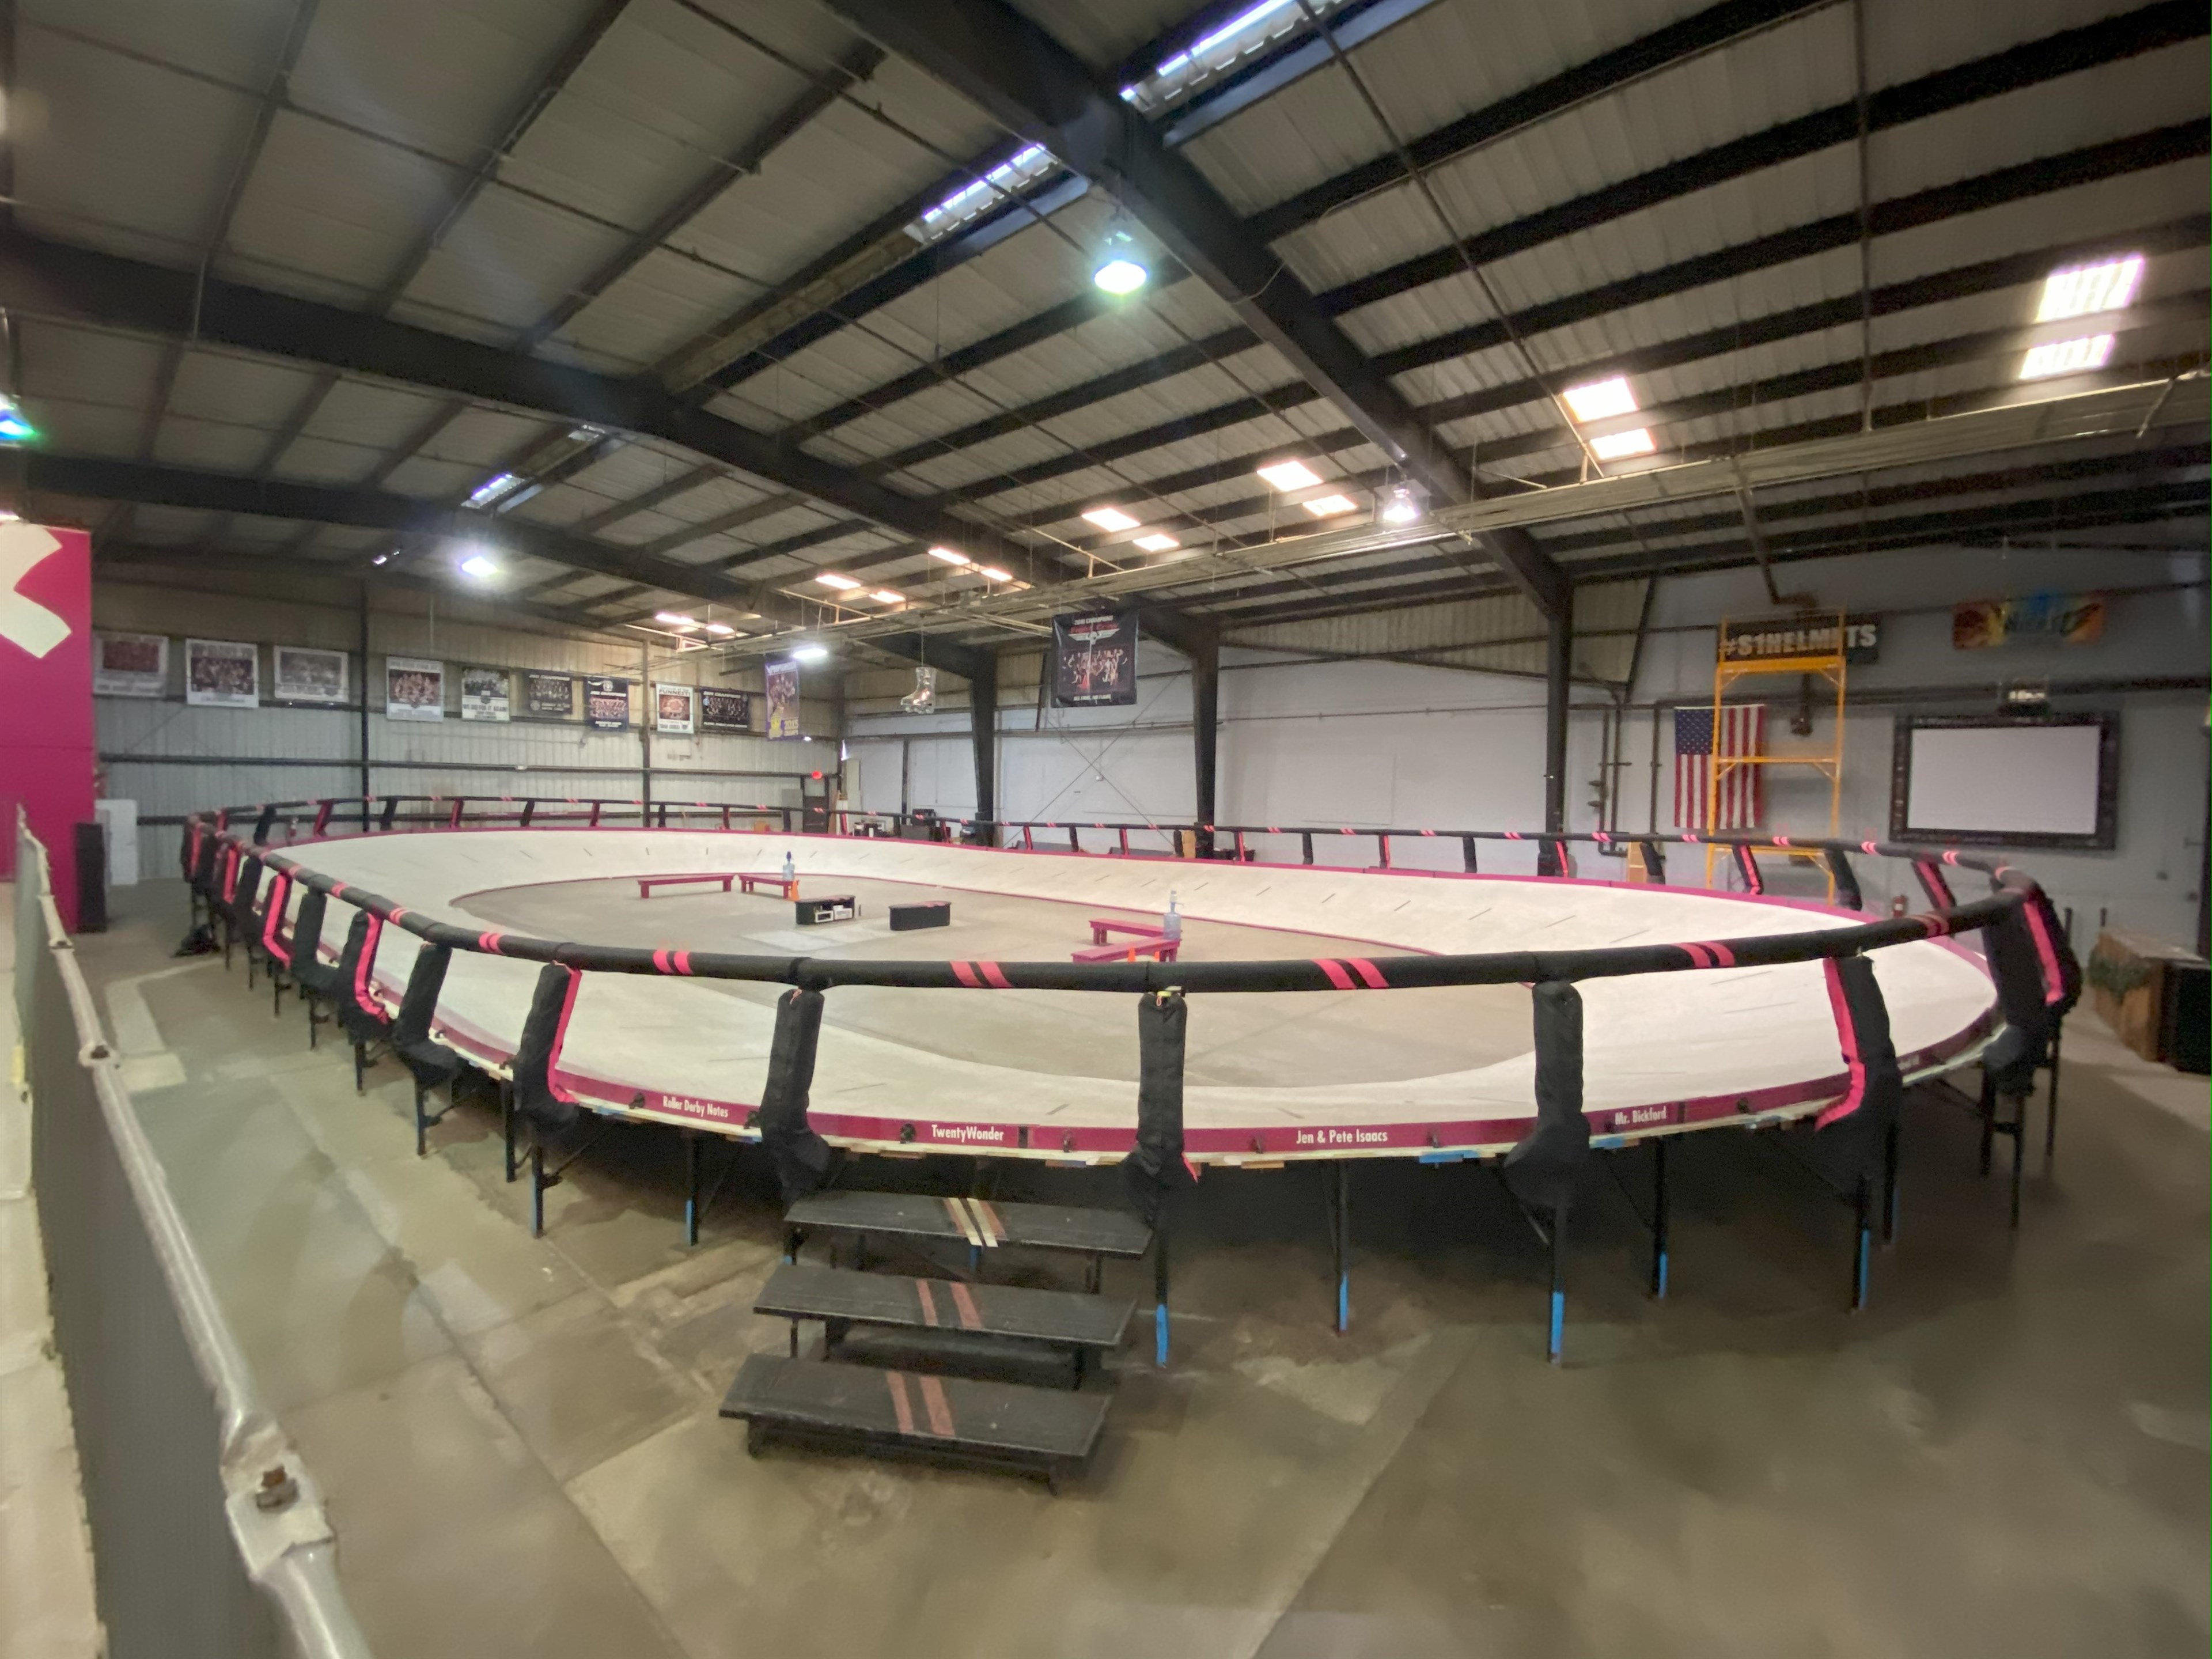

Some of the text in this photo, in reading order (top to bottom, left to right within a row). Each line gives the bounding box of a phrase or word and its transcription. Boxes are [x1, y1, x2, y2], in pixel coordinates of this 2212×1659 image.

[663, 1096, 728, 1118] Roller Derby Notes
[1615, 1105, 1666, 1125] Mr. Bickford
[931, 1124, 1004, 1142] TwentyWonder
[1296, 1129, 1388, 1144] Jen & Pete Isaacs
